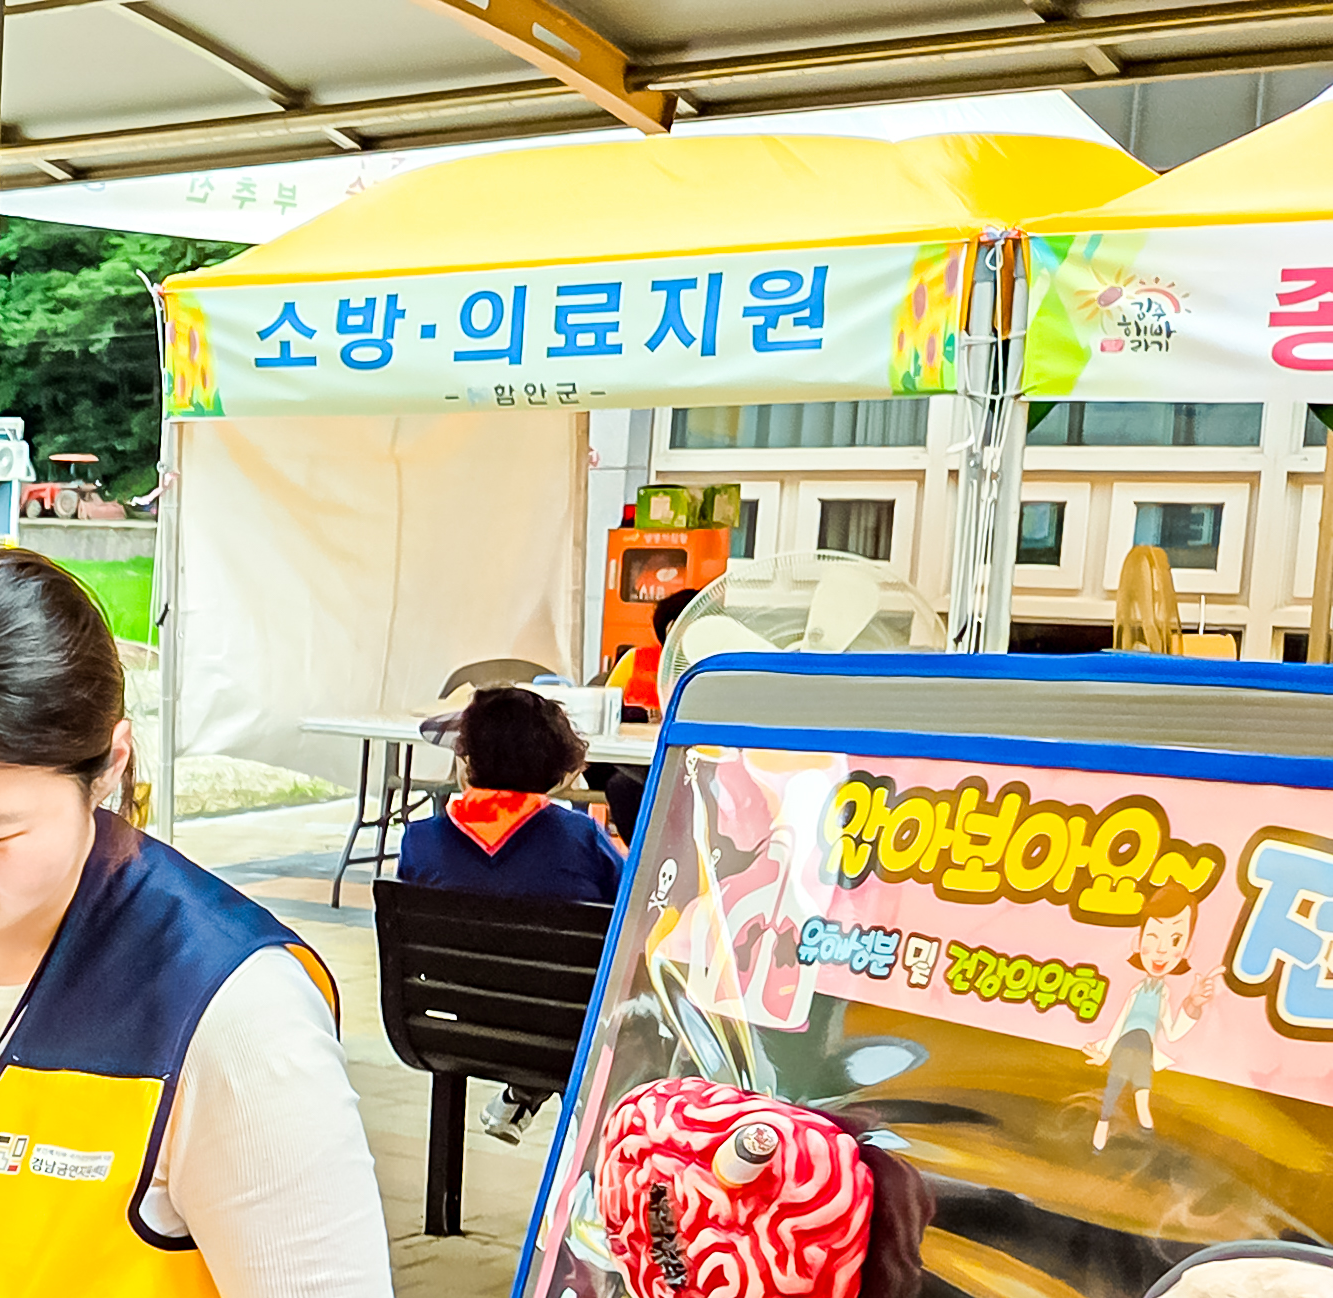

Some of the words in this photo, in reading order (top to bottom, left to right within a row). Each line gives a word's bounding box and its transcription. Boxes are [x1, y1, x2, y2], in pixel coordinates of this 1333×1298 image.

[254, 265, 828, 371] 소방·의료지원
[493, 382, 581, 407] 함안군
[820, 776, 1218, 919] 알아보아요~
[797, 915, 901, 979] 유해성분
[904, 933, 941, 987] 및
